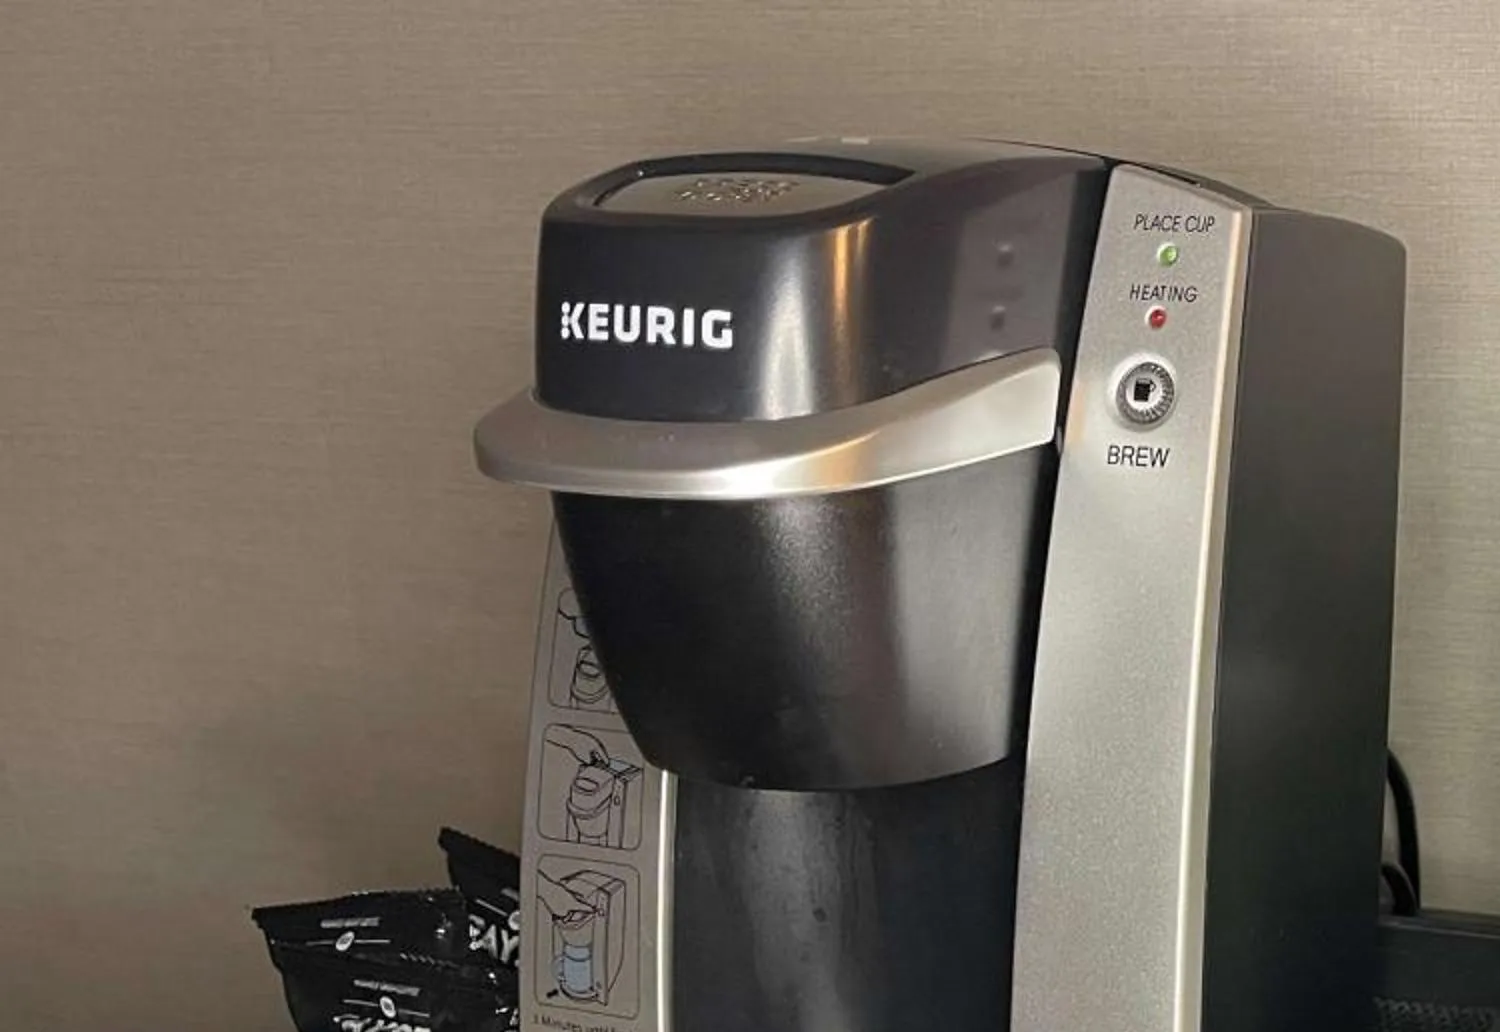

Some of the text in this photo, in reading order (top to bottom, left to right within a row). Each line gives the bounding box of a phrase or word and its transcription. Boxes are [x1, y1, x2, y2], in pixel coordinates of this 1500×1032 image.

[1133, 212, 1216, 234] PLACE CUP
[1128, 283, 1199, 303] HEATING
[561, 301, 734, 349] KEURIG
[1106, 444, 1171, 468] BREW
